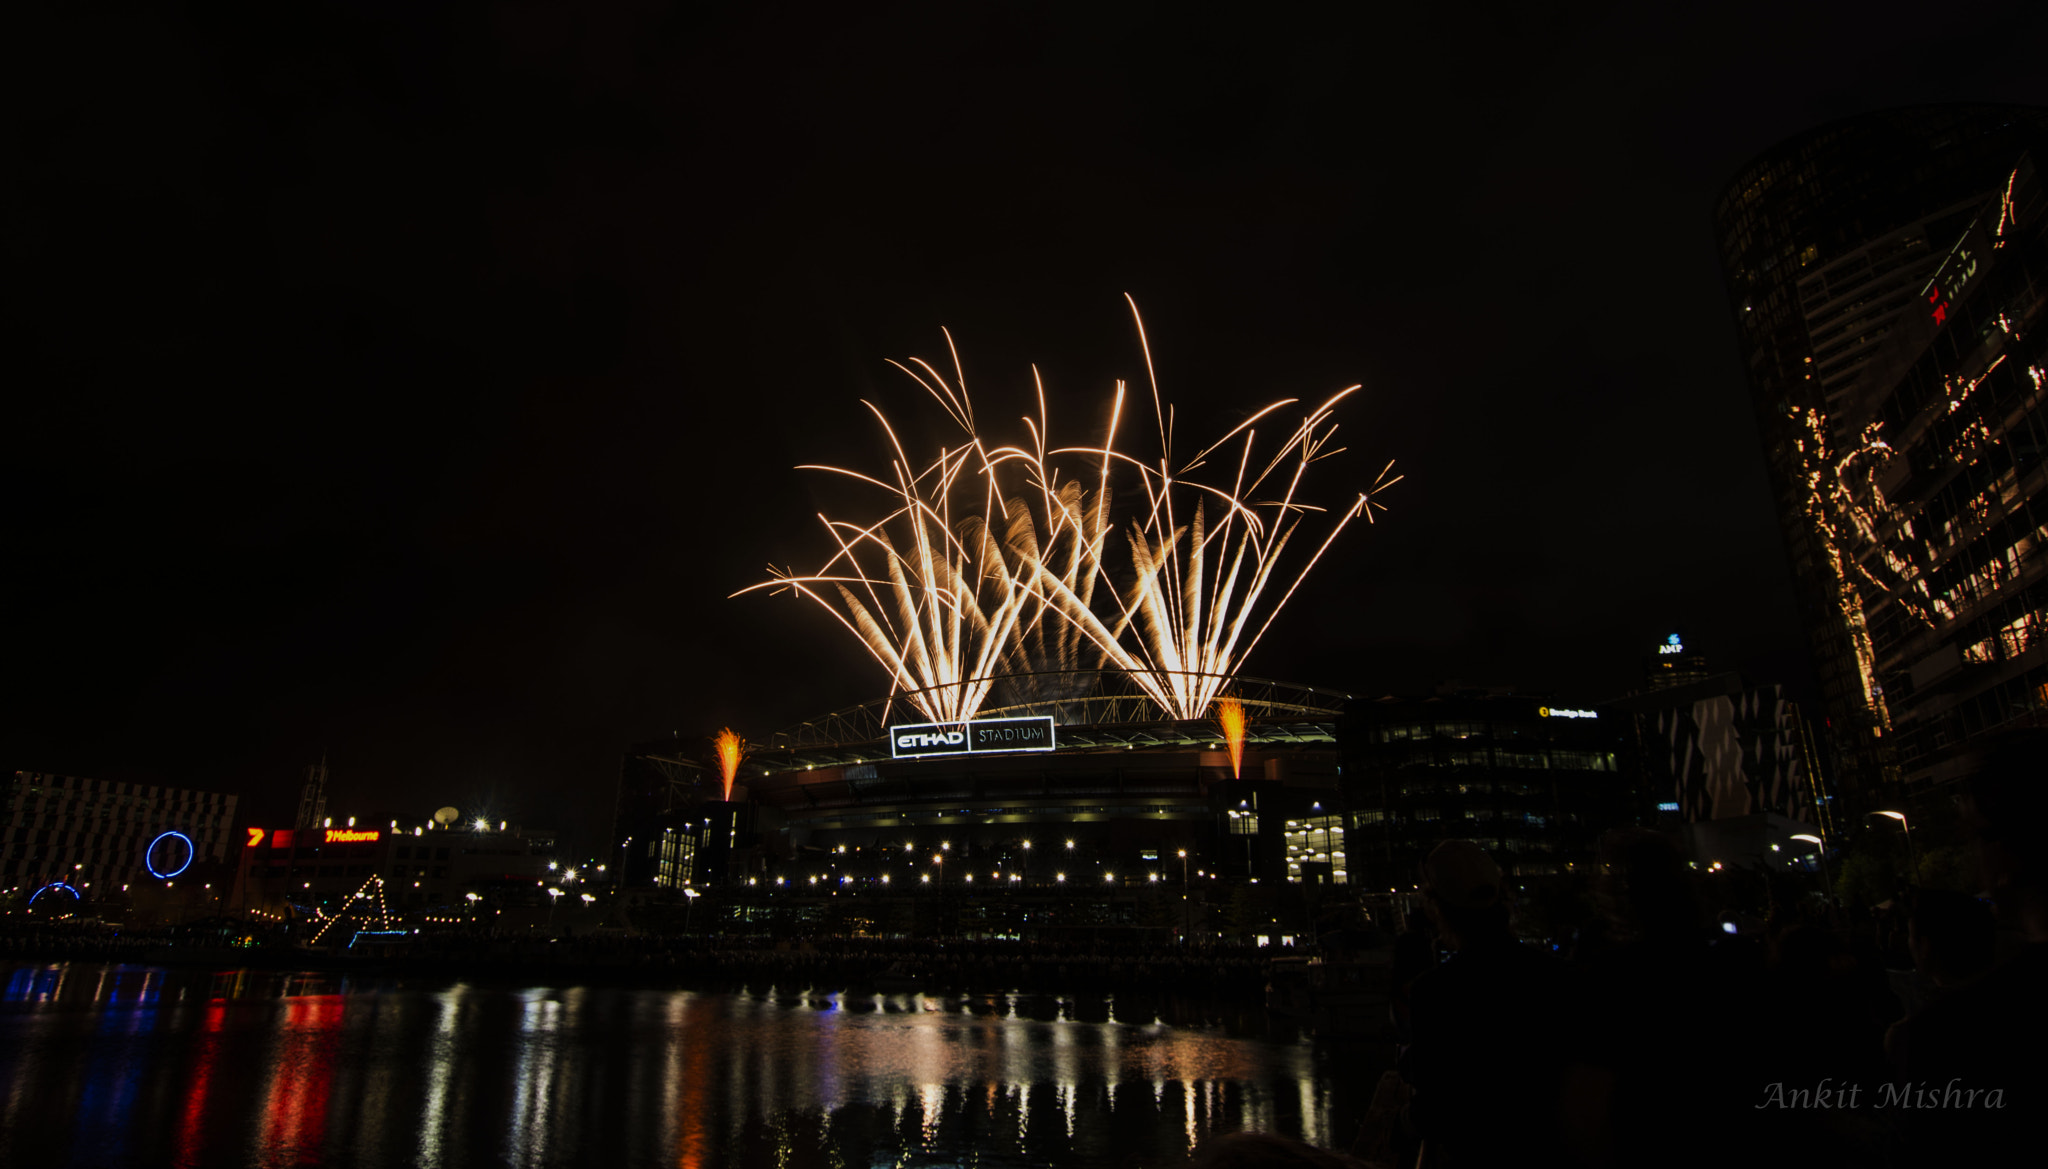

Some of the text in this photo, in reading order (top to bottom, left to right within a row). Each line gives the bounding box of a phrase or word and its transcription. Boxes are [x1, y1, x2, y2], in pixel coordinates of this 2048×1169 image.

[1659, 644, 1683, 654] AMP
[897, 727, 1044, 748] ETIHAD STADIUM
